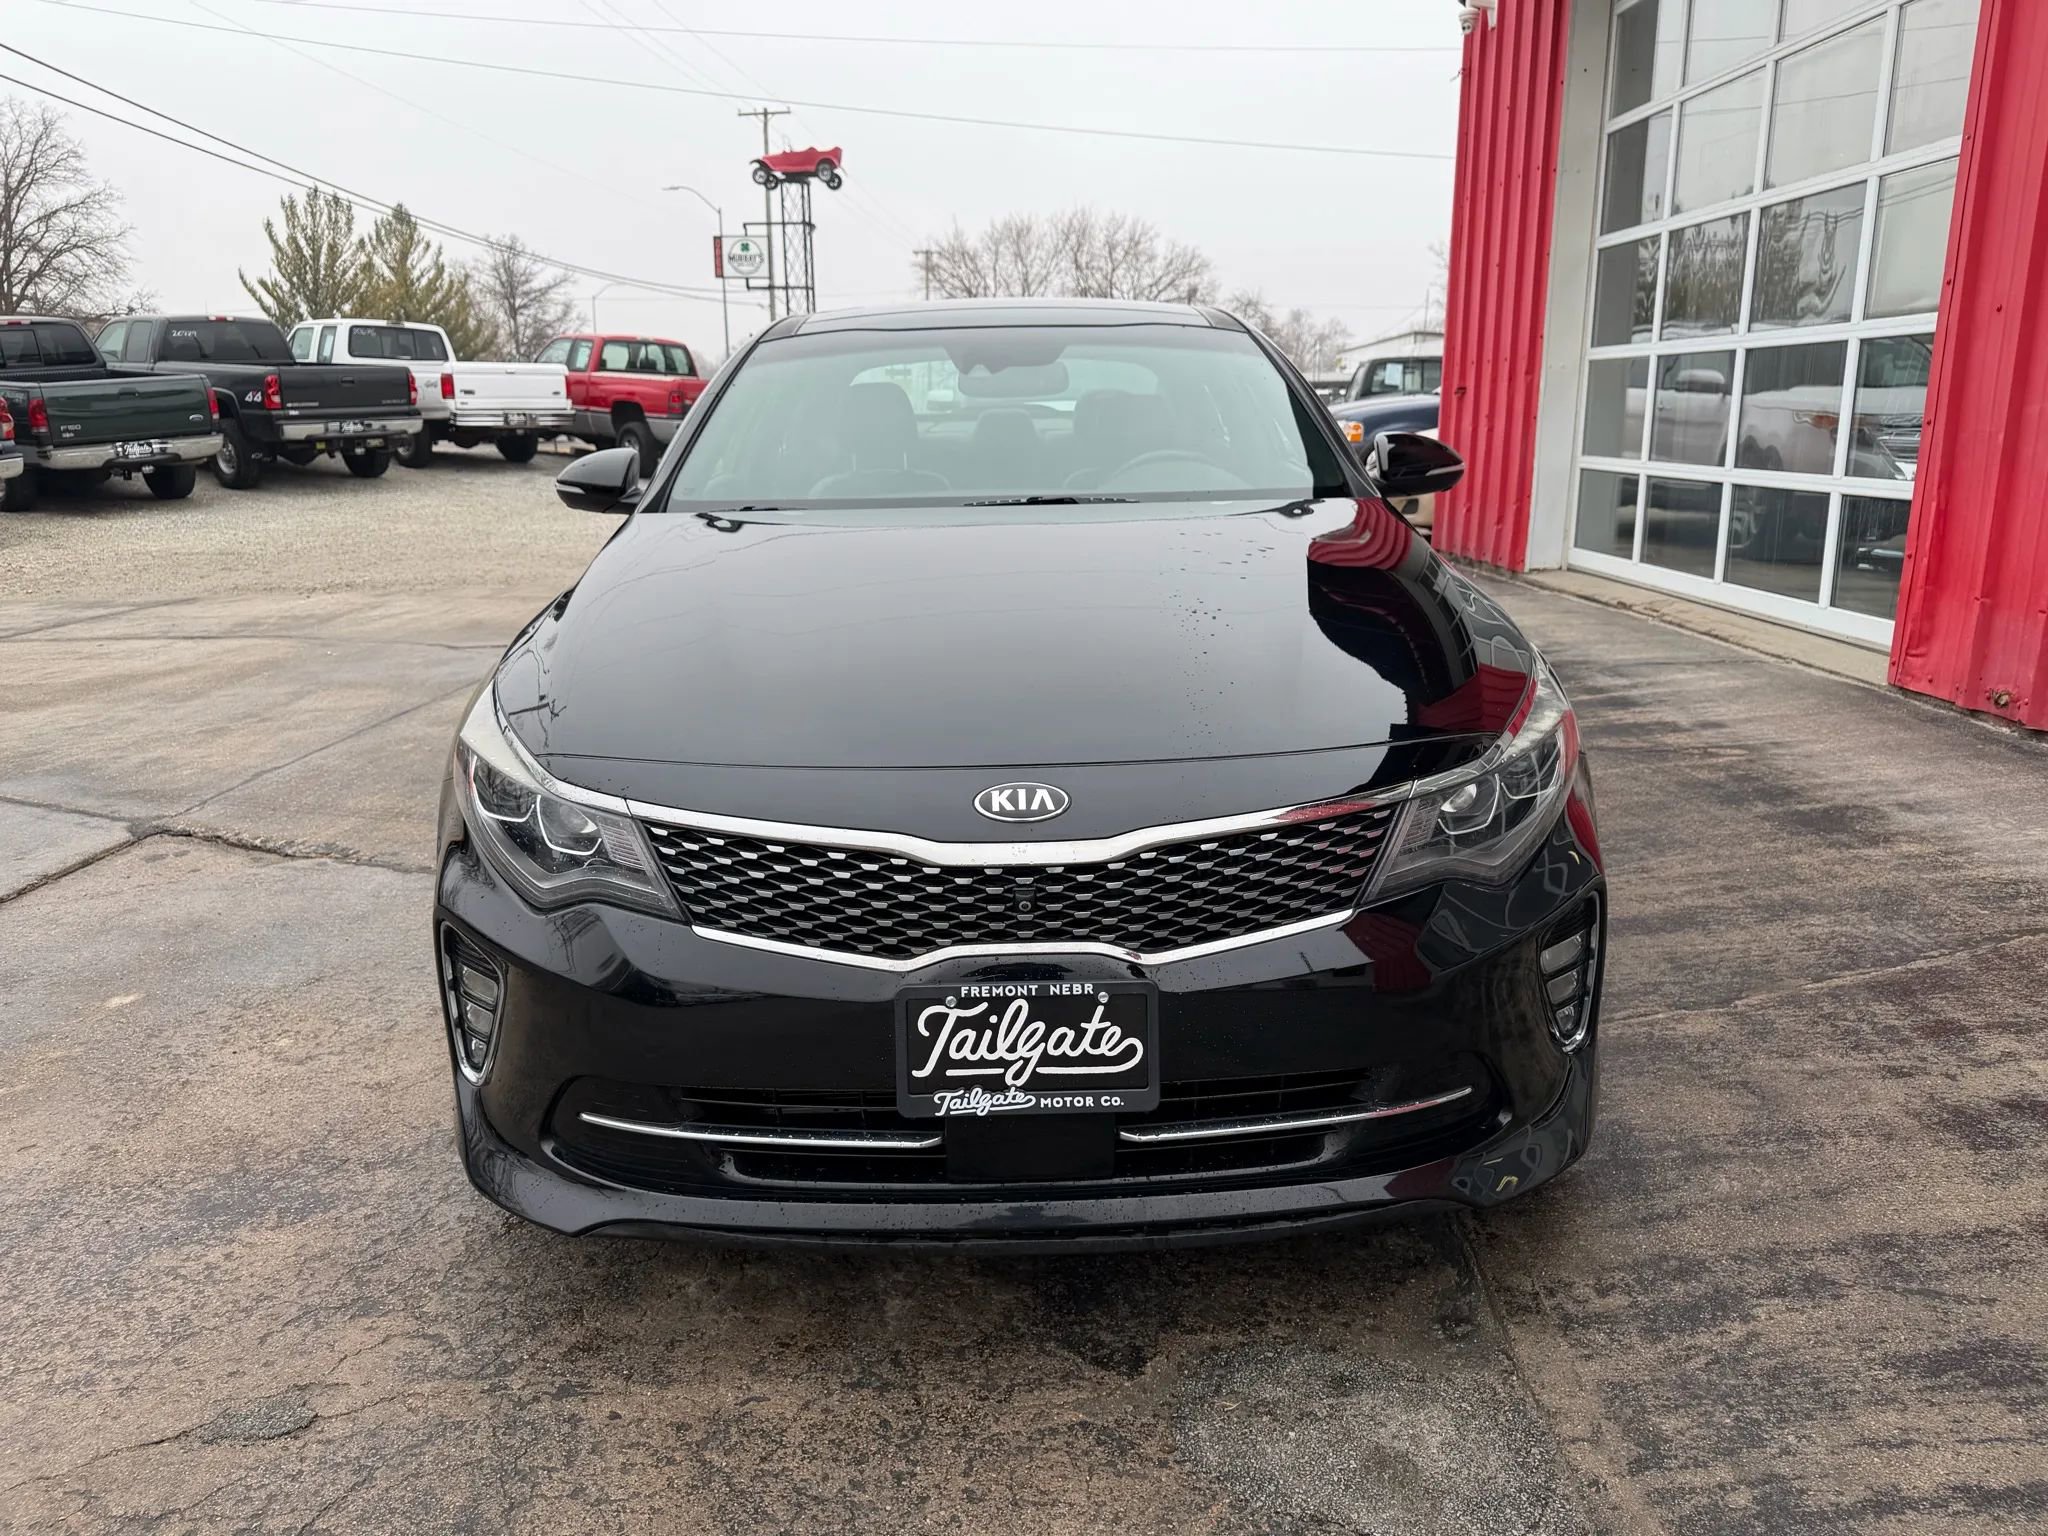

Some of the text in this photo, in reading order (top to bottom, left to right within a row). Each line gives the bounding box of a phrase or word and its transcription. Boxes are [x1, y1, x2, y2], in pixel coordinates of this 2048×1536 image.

[990, 788, 1056, 811] KIA
[960, 983, 1094, 998] FREMONT NEBR
[911, 998, 1144, 1086] Tailgate
[933, 1087, 1037, 1116] Tailgate
[1040, 1096, 1094, 1108] MOTOR
